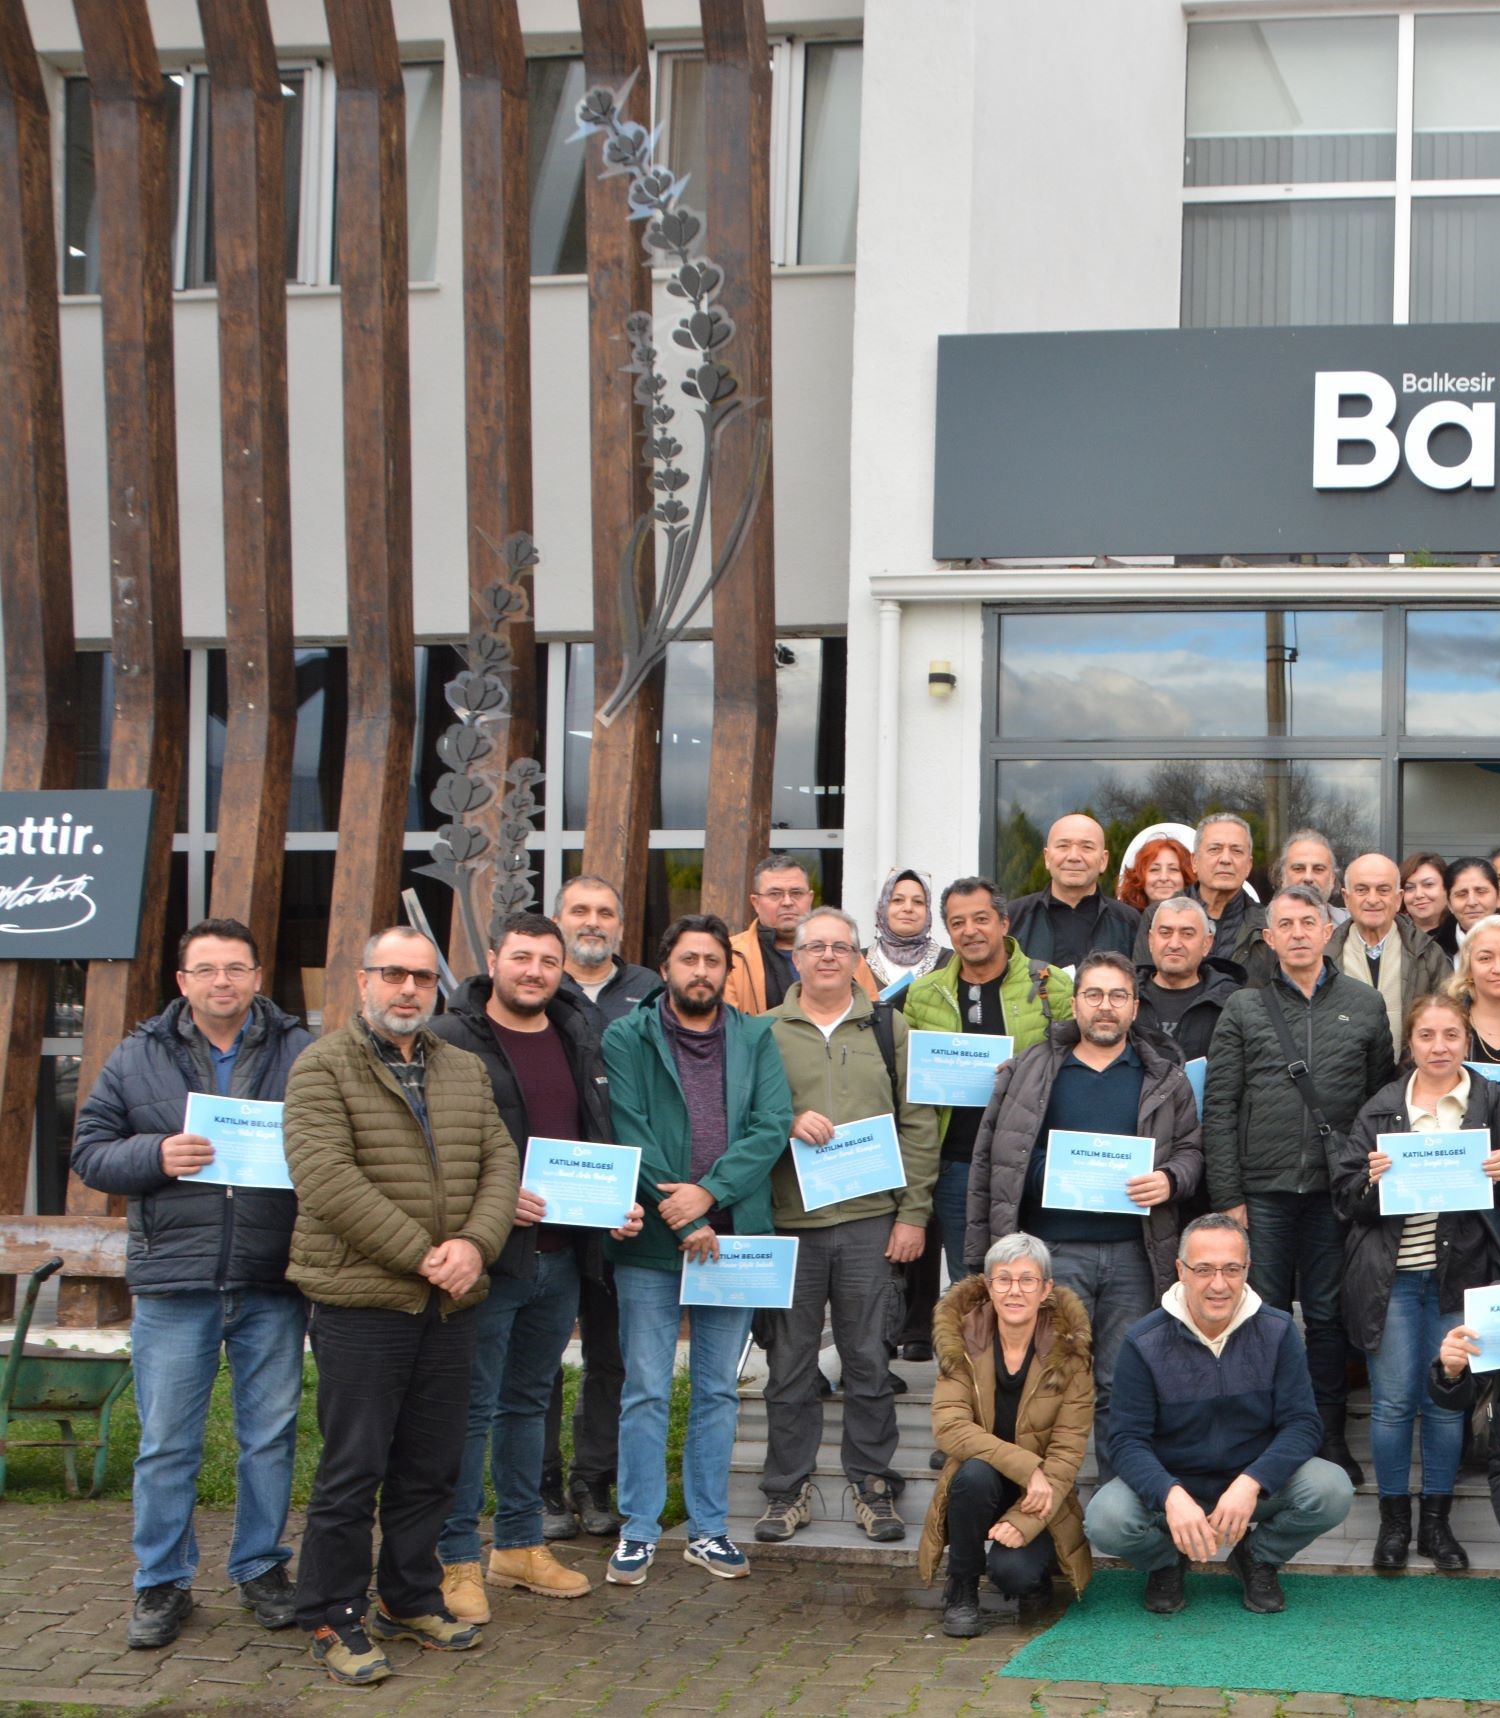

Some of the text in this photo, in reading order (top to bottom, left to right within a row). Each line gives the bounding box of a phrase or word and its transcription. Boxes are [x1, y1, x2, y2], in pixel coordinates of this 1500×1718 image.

[1402, 372, 1494, 392] Balıkesir
[1070, 1149, 1132, 1160] KATILIM BELGESİ
[1402, 1147, 1466, 1158] KATILIM BELGESİ
[549, 1158, 614, 1170] KATILIM BELGESİ
